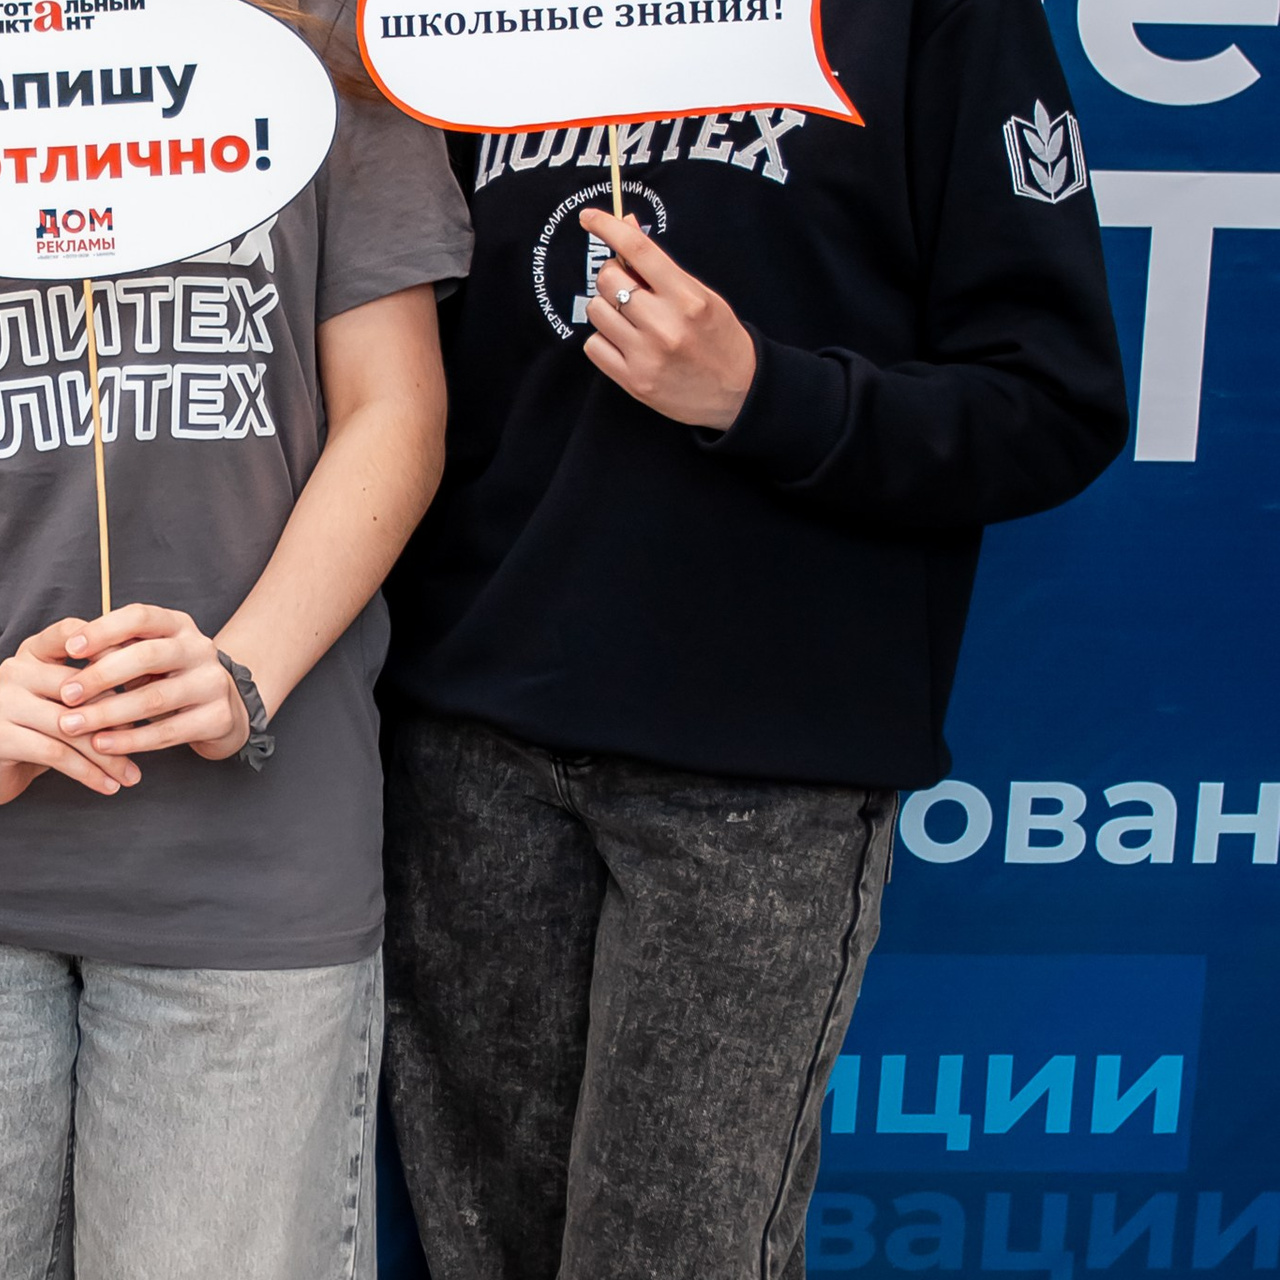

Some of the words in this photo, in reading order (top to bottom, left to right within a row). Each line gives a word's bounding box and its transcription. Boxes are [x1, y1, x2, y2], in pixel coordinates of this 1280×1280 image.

[380, 0, 603, 39] школьные
[36, 207, 113, 239] ДОМ
[539, 180, 643, 245] ПОЛИТЕХНИЧЕКИЙ
[36, 237, 116, 253] РЕКЛАМЫ
[532, 244, 574, 340] ДЗЕРЖИНСКИЙ
